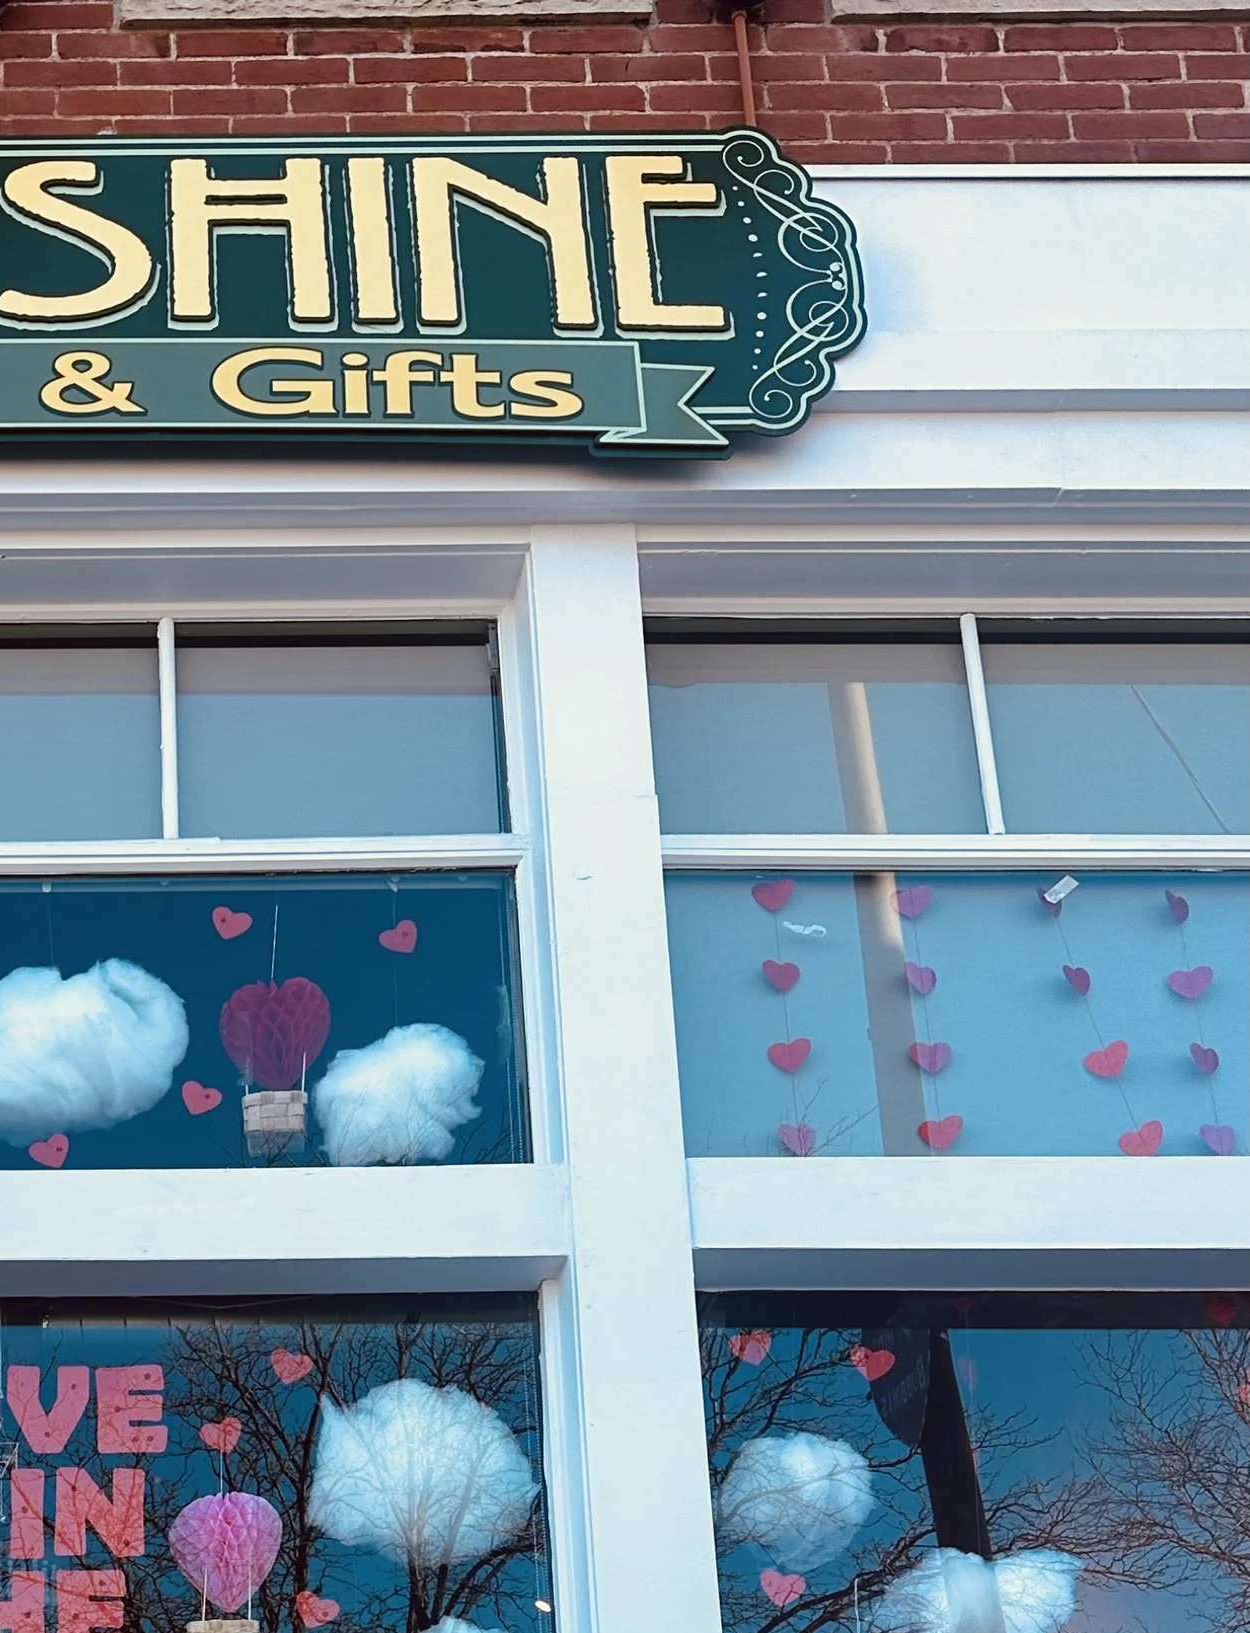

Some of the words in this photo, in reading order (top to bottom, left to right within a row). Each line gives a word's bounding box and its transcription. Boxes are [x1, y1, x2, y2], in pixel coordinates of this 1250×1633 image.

[39, 350, 144, 416] &
[210, 346, 584, 419] Gifts
[8, 1466, 146, 1560] IN
